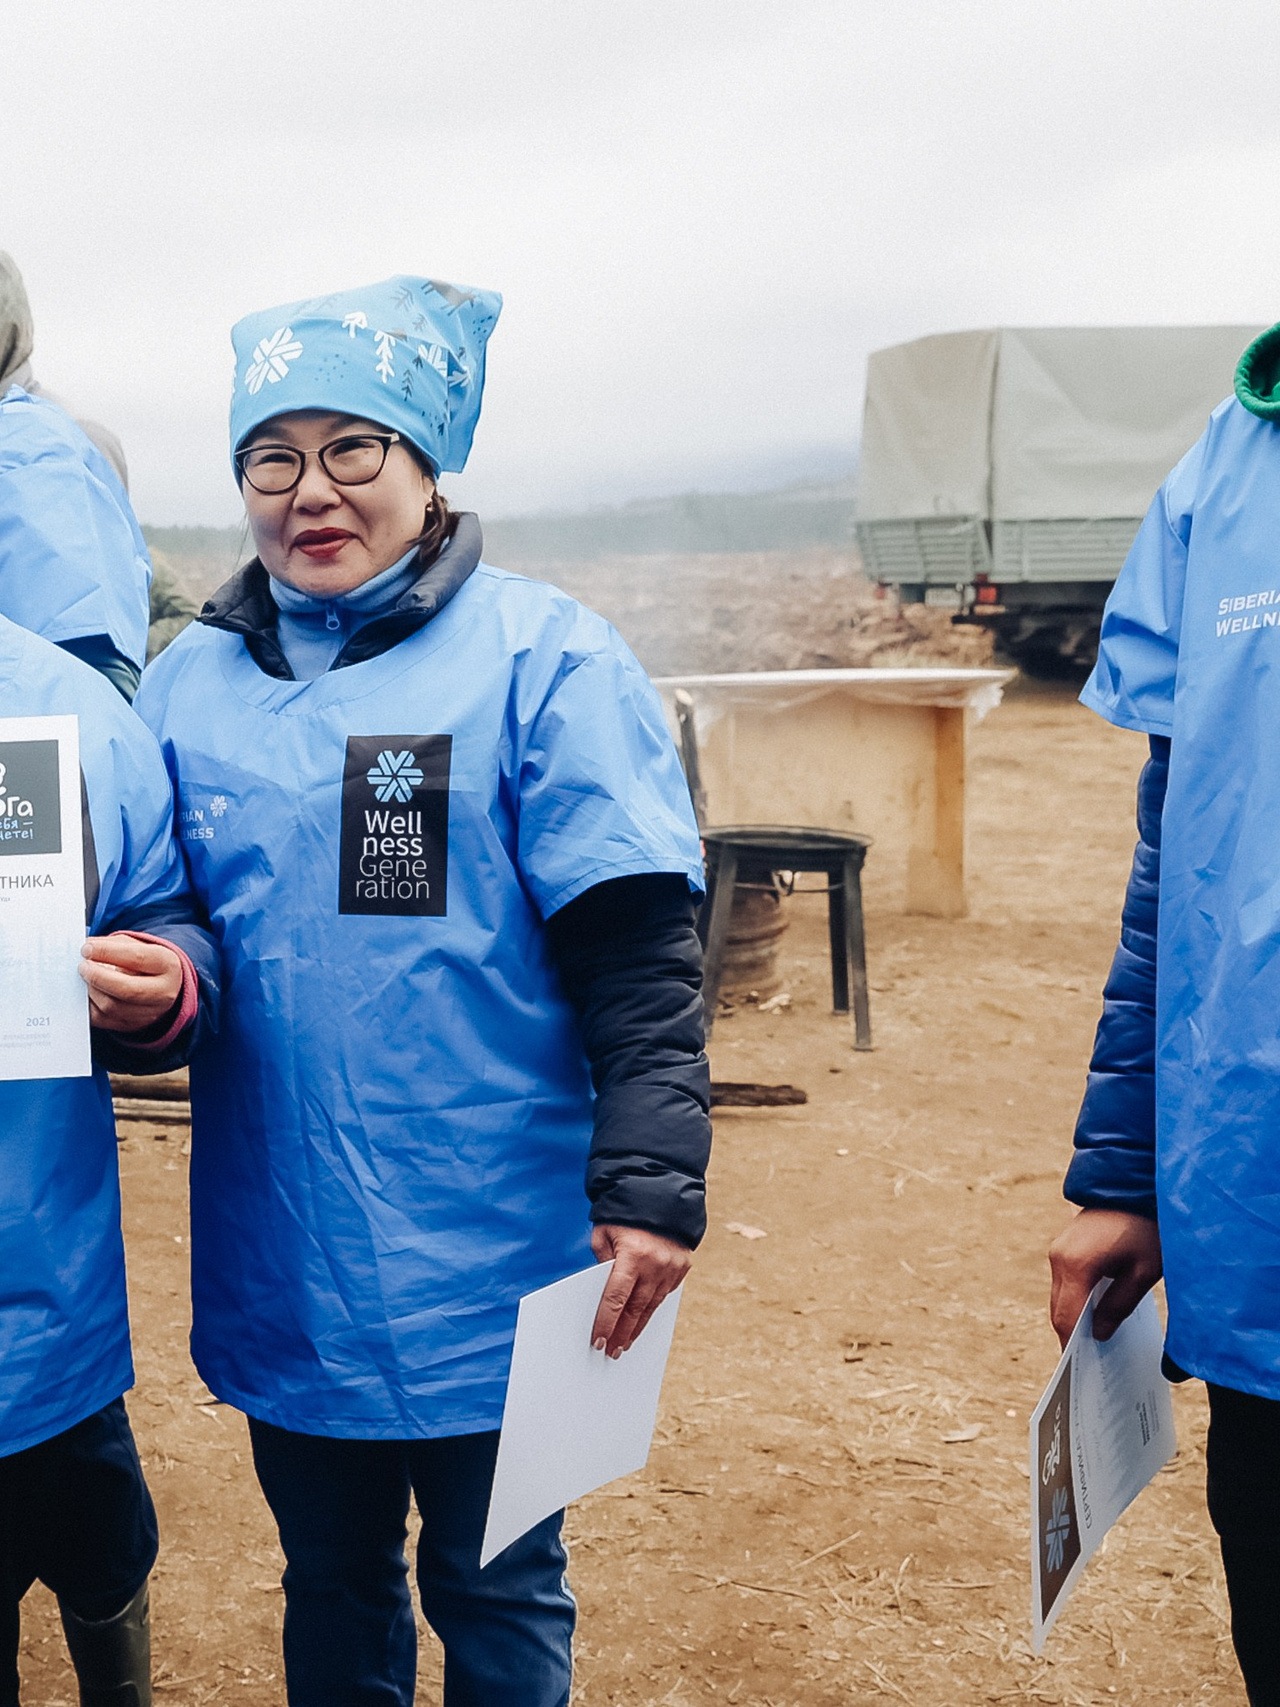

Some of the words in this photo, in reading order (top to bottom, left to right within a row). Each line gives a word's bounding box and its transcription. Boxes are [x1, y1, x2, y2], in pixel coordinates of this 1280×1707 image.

[1216, 611, 1280, 637] WELLN
[365, 810, 422, 834] Well
[363, 836, 424, 856] ness
[359, 853, 428, 878] Gene
[356, 877, 430, 899] ration
[26, 1017, 50, 1027] 2021
